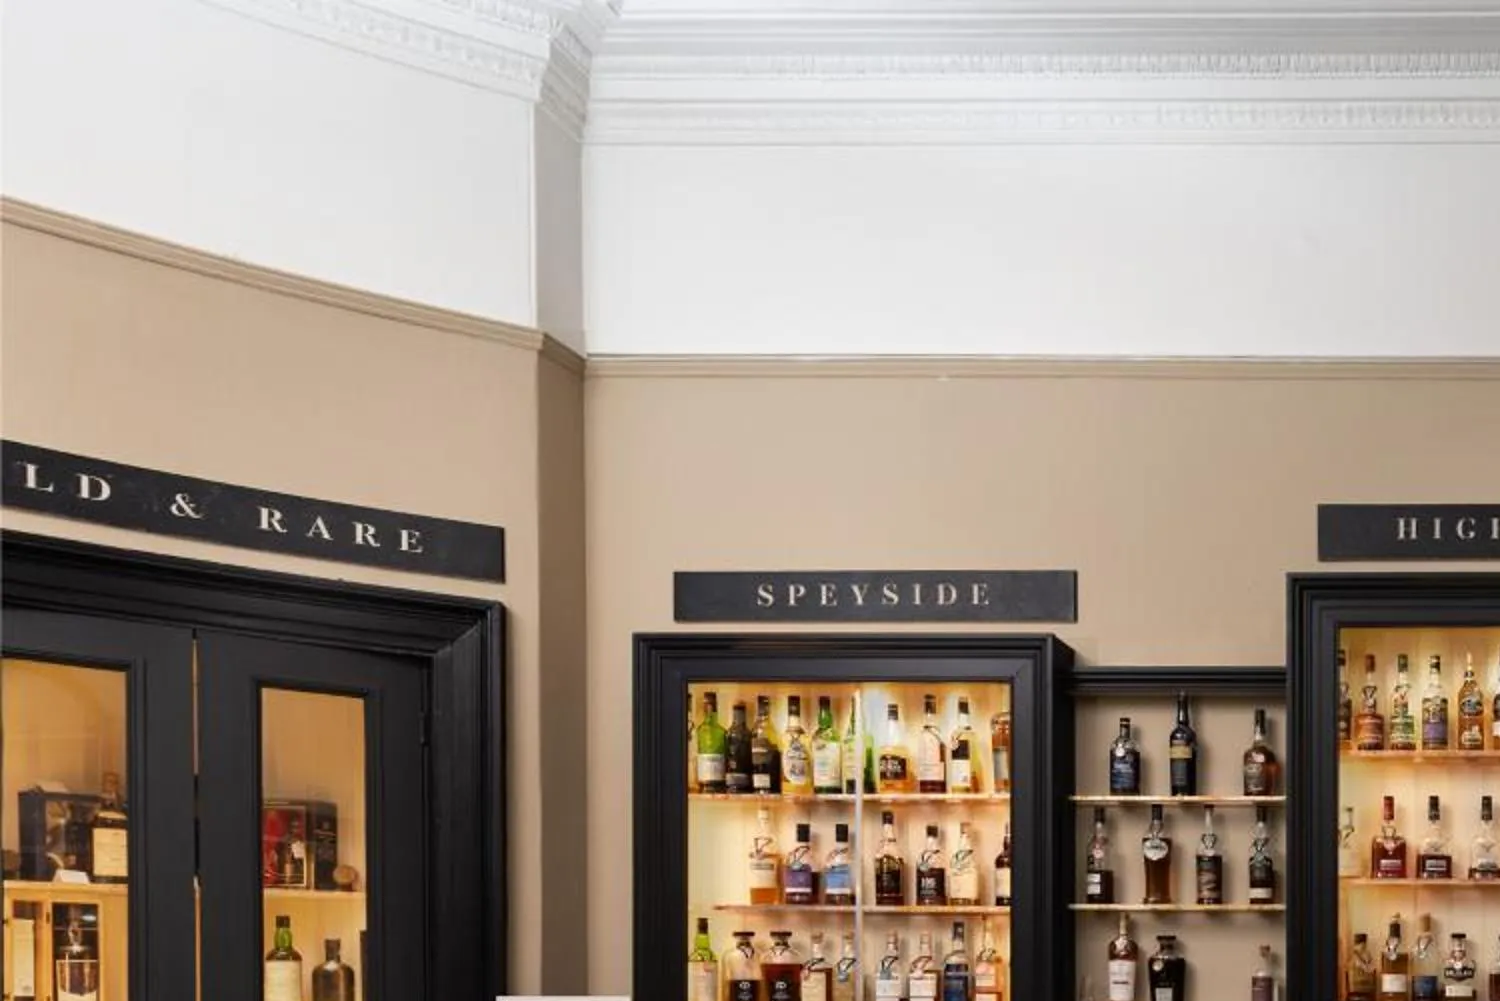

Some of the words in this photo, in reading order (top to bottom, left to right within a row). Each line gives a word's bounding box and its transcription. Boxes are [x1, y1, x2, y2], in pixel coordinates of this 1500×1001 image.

[19, 461, 112, 502] LD
[170, 492, 201, 519] &
[257, 506, 424, 553] RARE
[756, 583, 990, 607] SPEYSIDE
